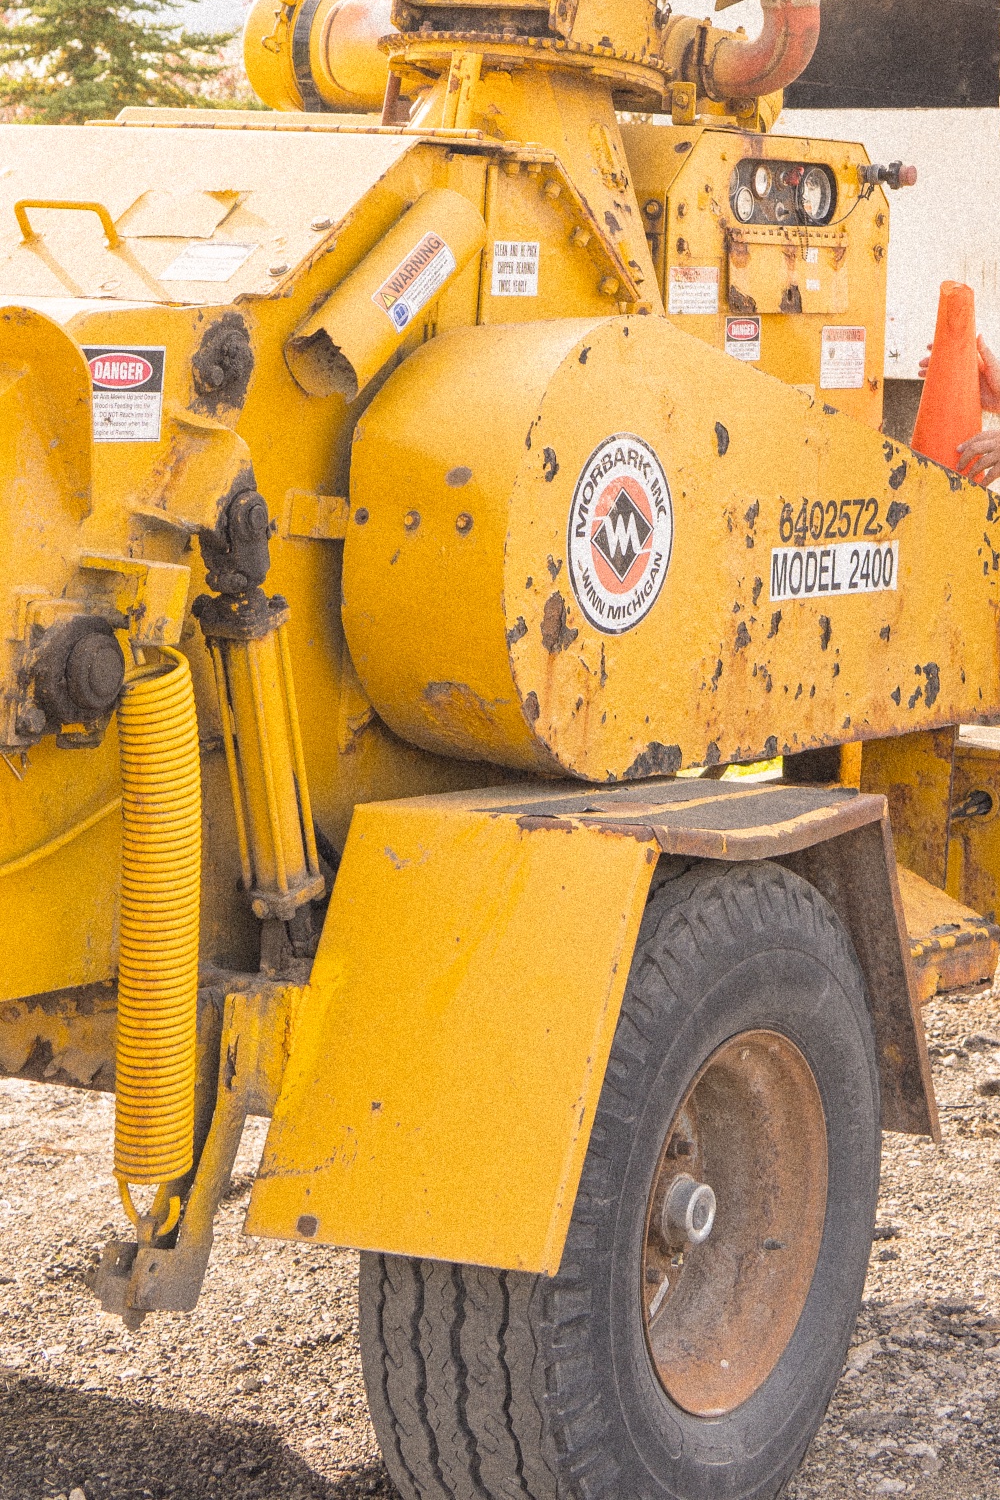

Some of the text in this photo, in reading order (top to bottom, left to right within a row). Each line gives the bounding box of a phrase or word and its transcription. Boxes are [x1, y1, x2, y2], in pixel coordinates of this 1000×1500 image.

[388, 237, 441, 294] WARNING
[498, 280, 511, 292] TWICE
[731, 324, 755, 336] DANGER
[94, 361, 144, 380] DANGER
[606, 552, 663, 620] MICHIGAN
[771, 548, 894, 597] MODEL 2400
